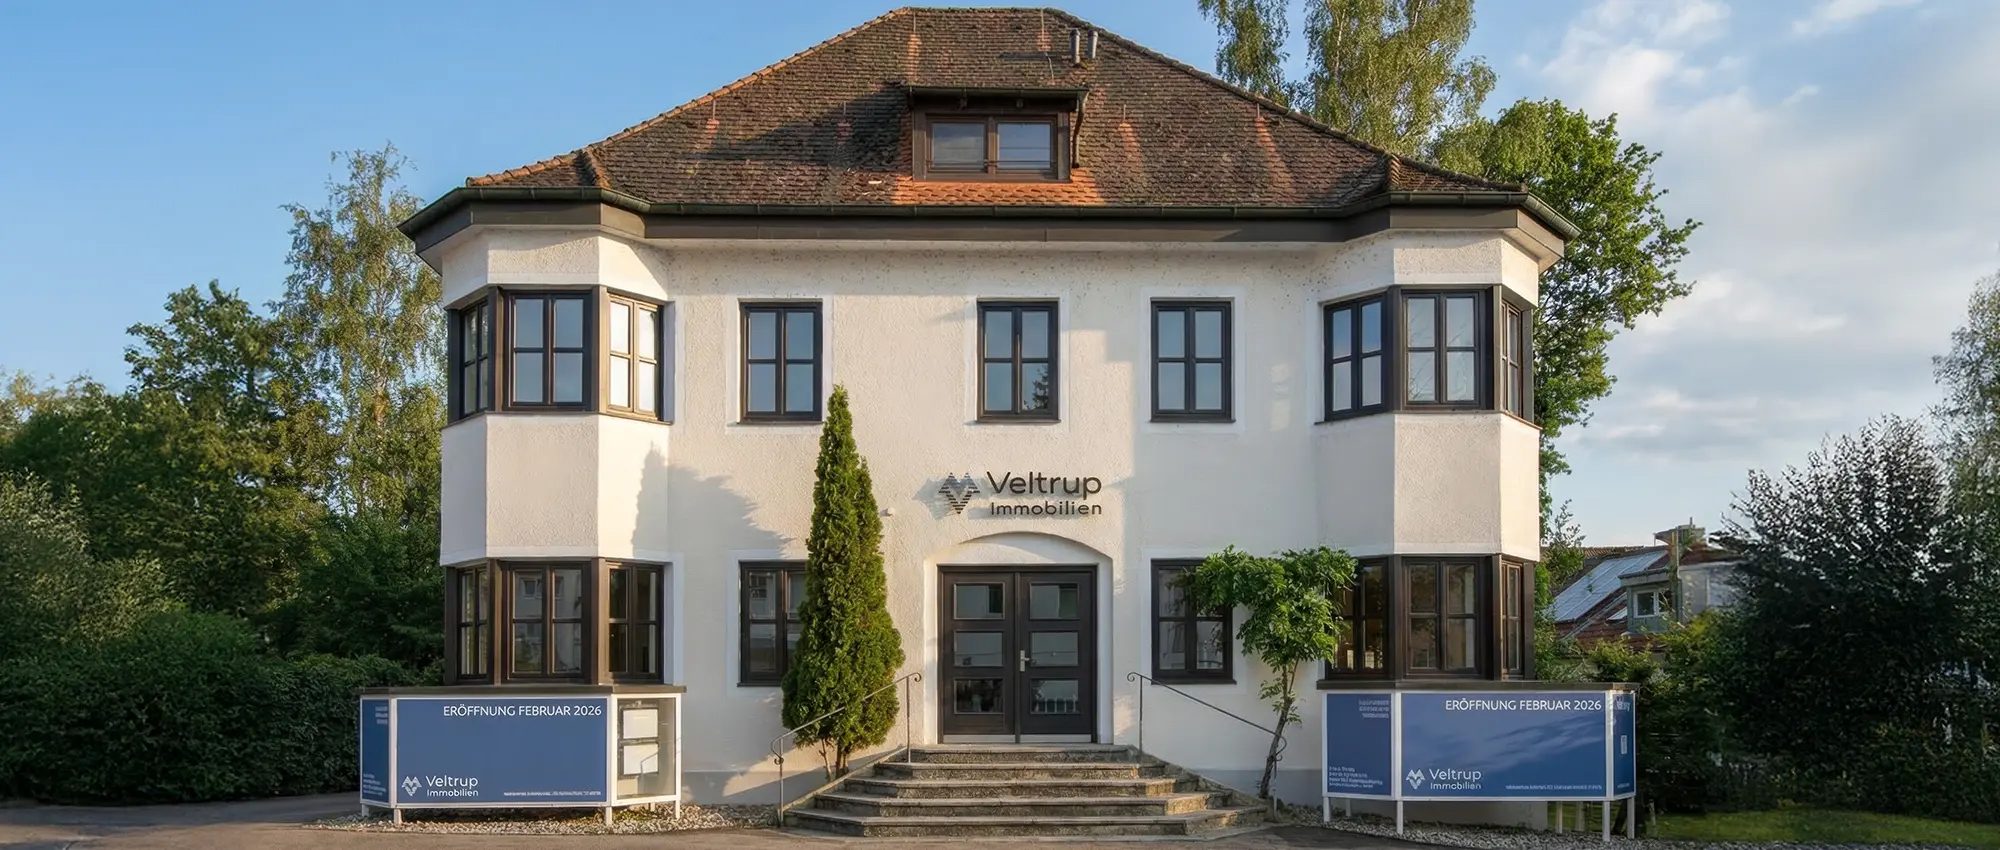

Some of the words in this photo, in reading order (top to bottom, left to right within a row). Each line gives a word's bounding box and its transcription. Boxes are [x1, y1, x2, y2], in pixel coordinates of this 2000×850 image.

[986, 471, 1102, 500] Veltrup
[991, 501, 1102, 516] Immobilien
[443, 704, 516, 717] ERÖFFNUNG
[518, 705, 571, 717] FEBRUAR
[573, 705, 602, 716] 2026
[1445, 698, 1517, 711] ERÖFFNUNG
[1519, 700, 1572, 711] FEBRUAR
[1573, 700, 1602, 711] 2026
[425, 775, 479, 790] Veltrup
[1428, 768, 1482, 783] Veltrup
[1430, 781, 1482, 790] Immobilien
[426, 789, 479, 797] Immobilien
